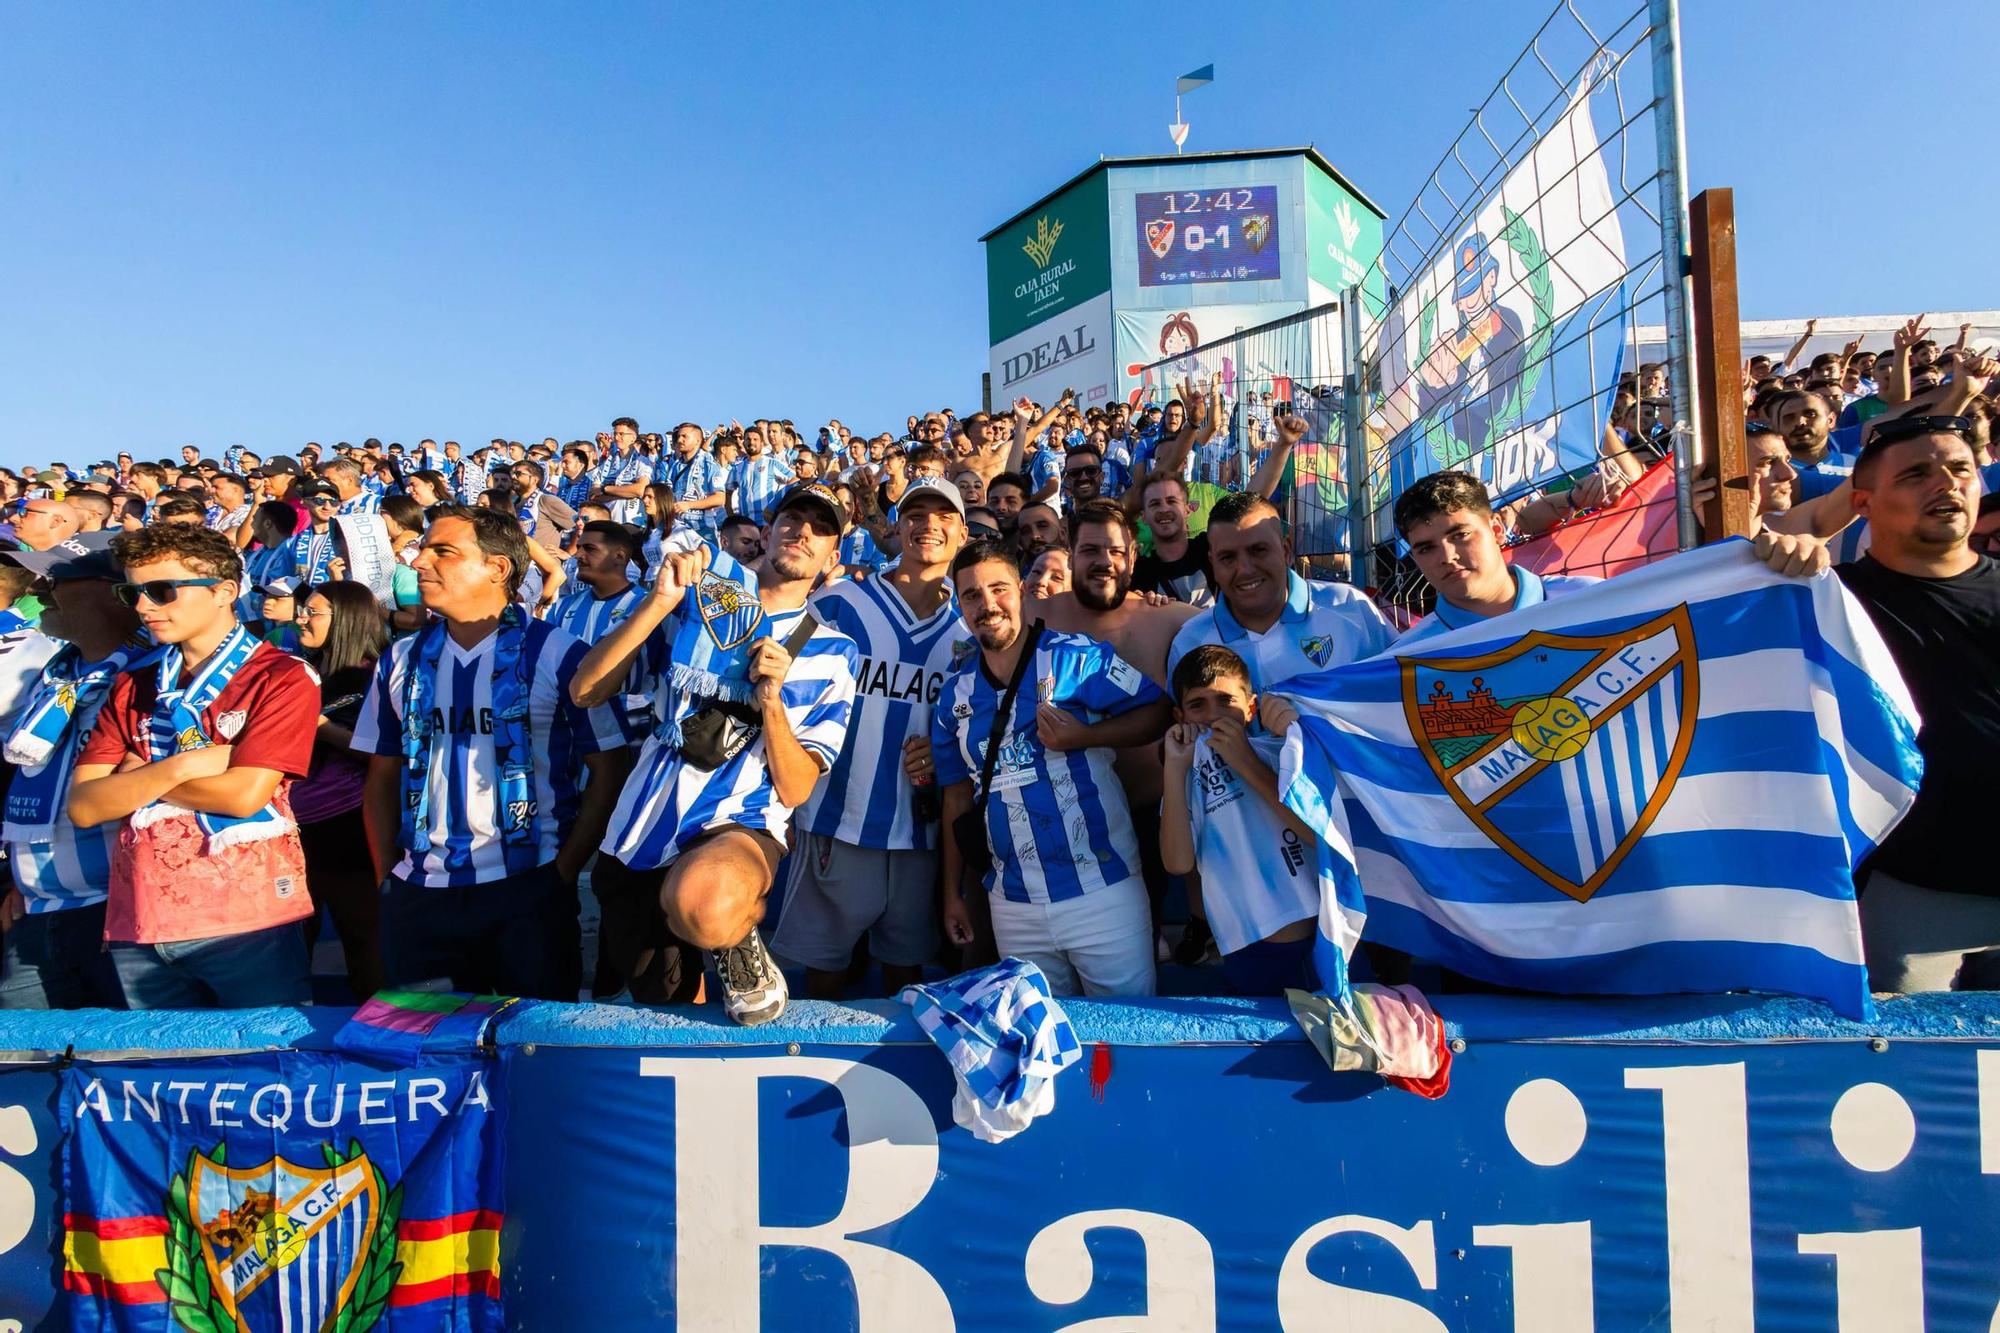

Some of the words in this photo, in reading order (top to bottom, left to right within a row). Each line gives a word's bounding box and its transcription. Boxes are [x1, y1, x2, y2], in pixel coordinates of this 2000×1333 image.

[1164, 189, 1254, 214] 12:42
[1184, 225, 1230, 251] 0-1
[1014, 278, 1039, 298] CAJA
[1040, 258, 1076, 286] RURAL
[1034, 280, 1060, 304] JAEN
[1002, 325, 1095, 386] IDEAL
[856, 658, 944, 705] MALAG
[431, 706, 494, 735] ALAG
[1478, 695, 1601, 783] MALAGA
[1596, 647, 1656, 695] C.F.
[724, 723, 762, 760] Reebok
[76, 1070, 495, 1135] ANTEQUERA
[640, 1049, 2000, 1333] Basili
[231, 1216, 307, 1286] MALAGA
[304, 1183, 342, 1217] C.F.
